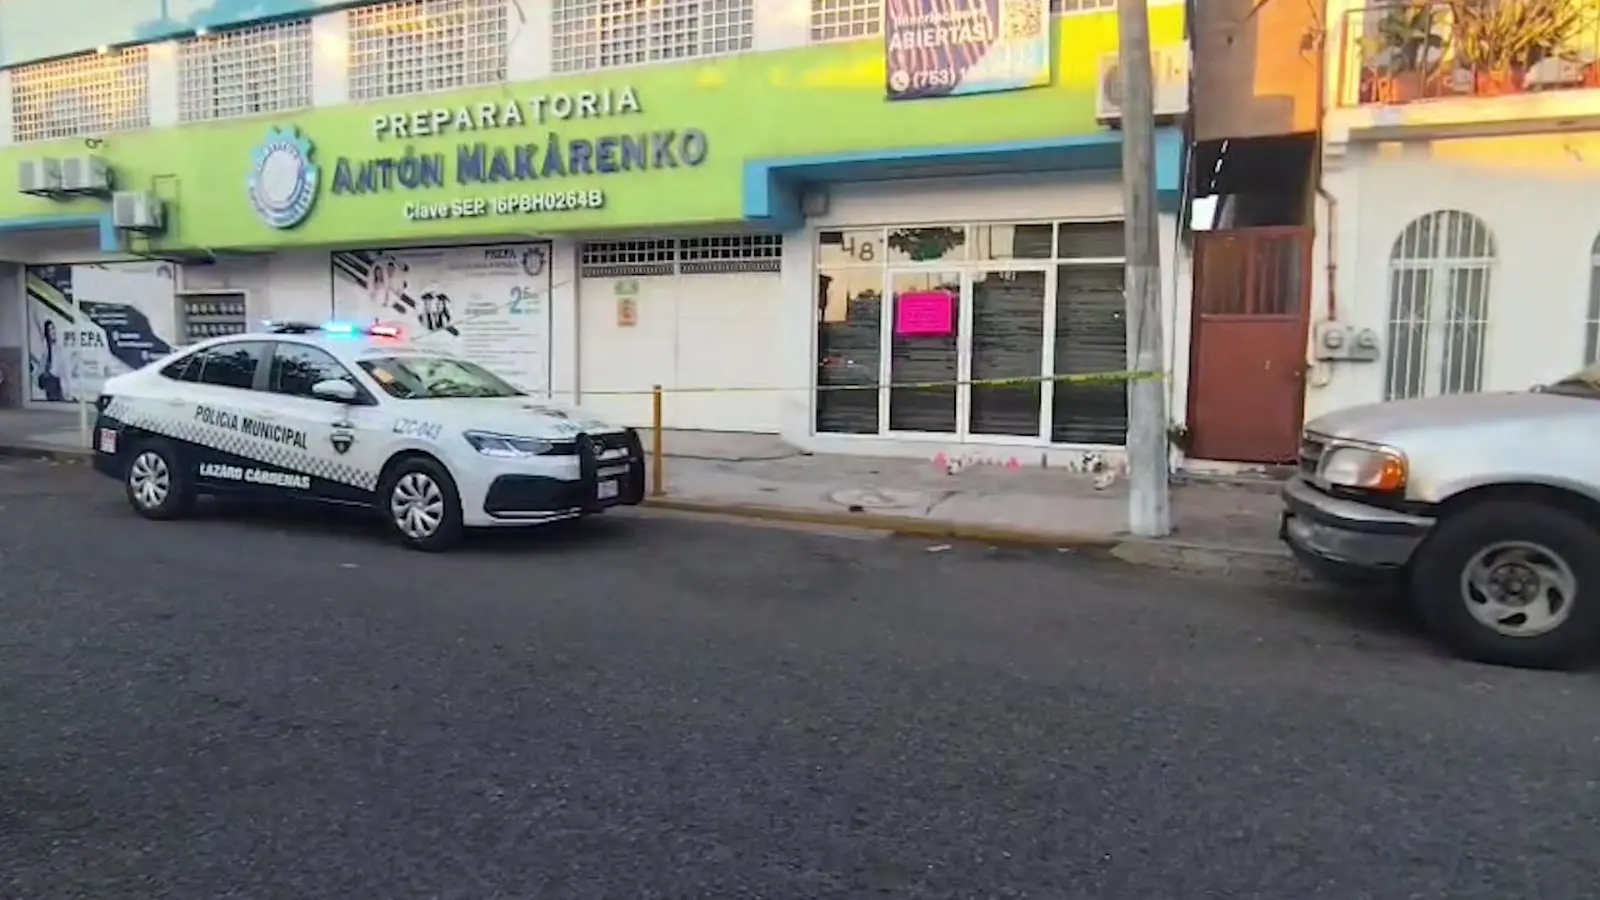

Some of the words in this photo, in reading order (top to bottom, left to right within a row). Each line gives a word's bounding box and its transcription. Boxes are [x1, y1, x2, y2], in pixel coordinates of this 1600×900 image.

[373, 86, 642, 138] PREPARATORIA
[404, 203, 449, 220] Clave
[241, 416, 308, 450] MUNICIPAL
